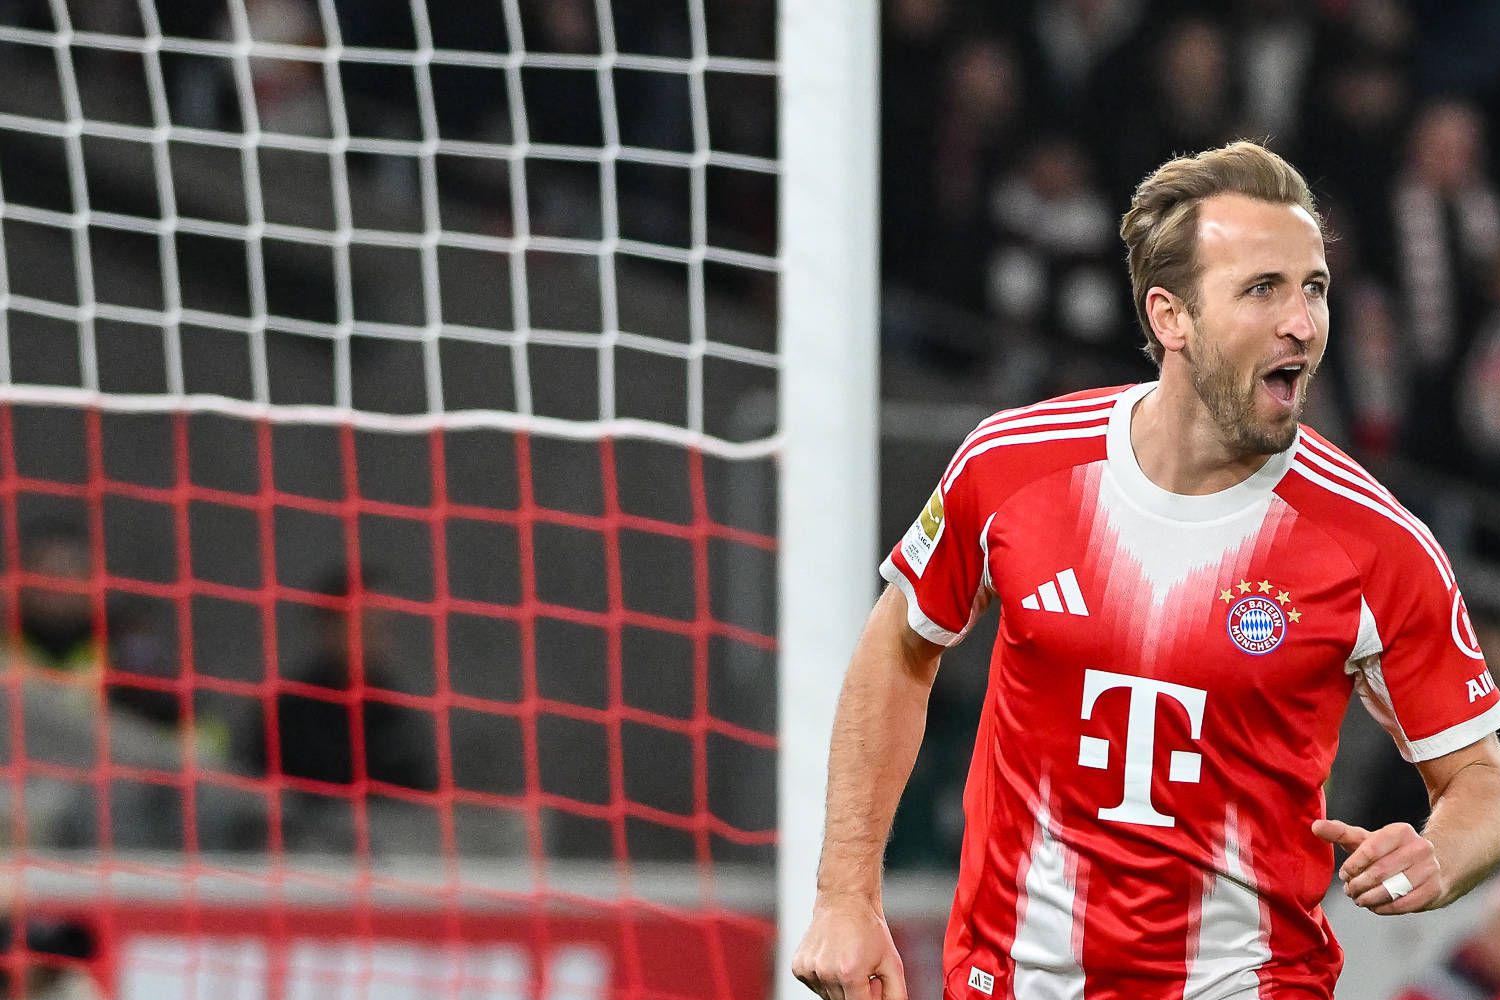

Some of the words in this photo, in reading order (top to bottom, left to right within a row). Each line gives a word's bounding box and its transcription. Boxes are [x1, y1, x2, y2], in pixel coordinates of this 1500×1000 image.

[1234, 604, 1248, 617] FC
[1249, 600, 1283, 627] BAYERN
[1465, 667, 1496, 703] All
[1077, 668, 1208, 828] T
